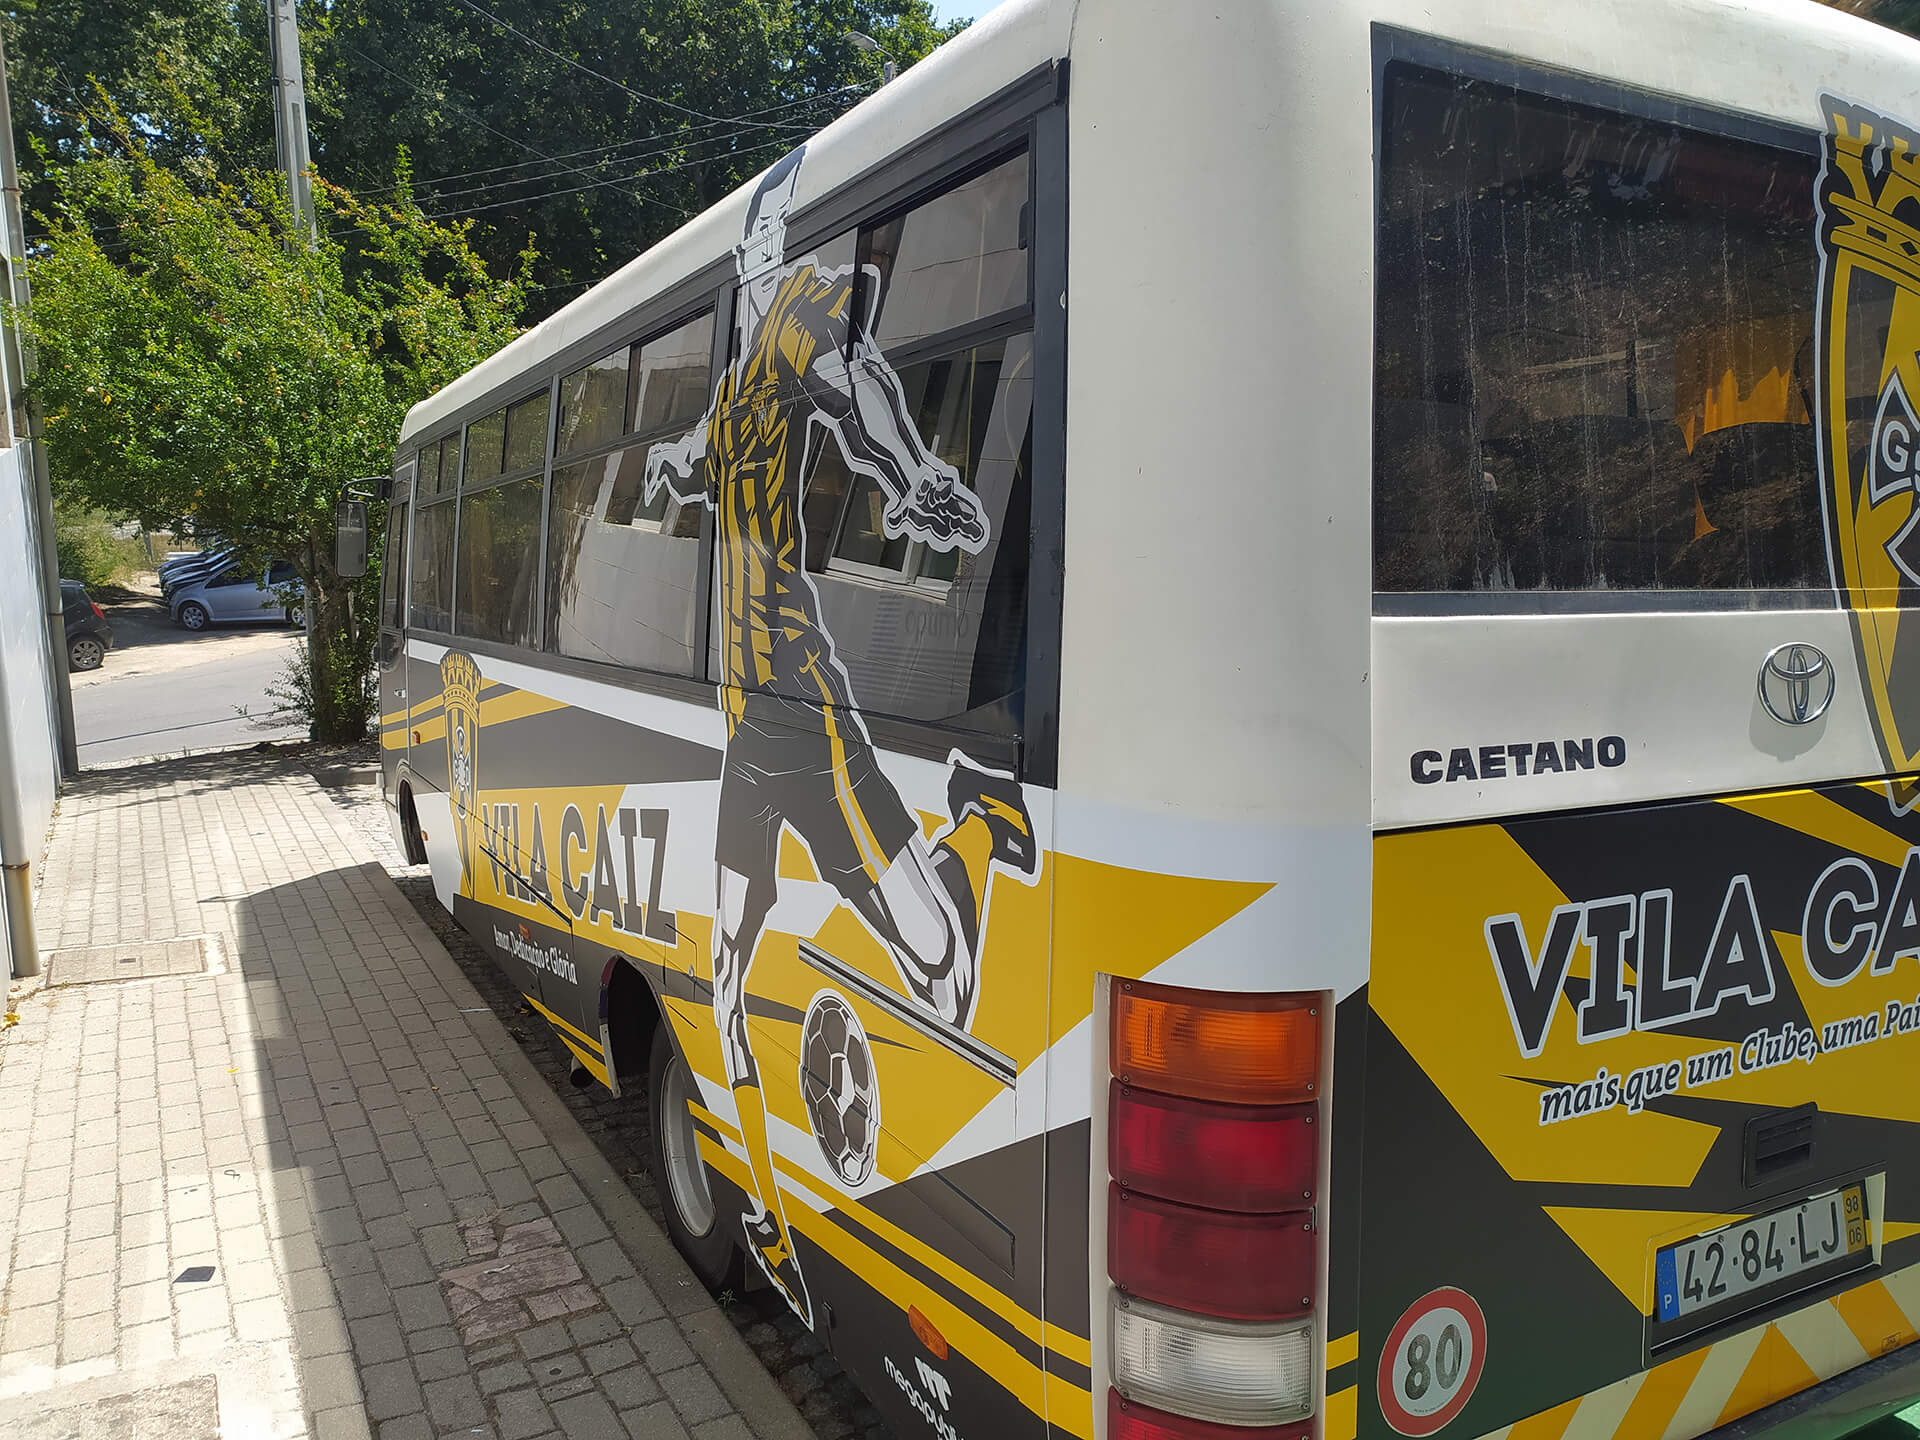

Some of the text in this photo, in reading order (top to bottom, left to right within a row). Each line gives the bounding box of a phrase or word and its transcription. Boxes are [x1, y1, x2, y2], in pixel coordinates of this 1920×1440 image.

[1409, 735, 1627, 785] CAETANO
[481, 801, 679, 950] VILA CAIZ
[1484, 874, 1776, 1058] VILA
[1539, 1066, 1622, 1127] mais
[1623, 1056, 1682, 1115] que
[1687, 1046, 1735, 1088] um
[1739, 1021, 1820, 1066] Clube,
[1821, 1011, 1881, 1055] uma
[1844, 1194, 1860, 1215] 98
[1848, 1226, 1863, 1246] 06
[1663, 1293, 1673, 1310] P
[1403, 1323, 1464, 1401] 80
